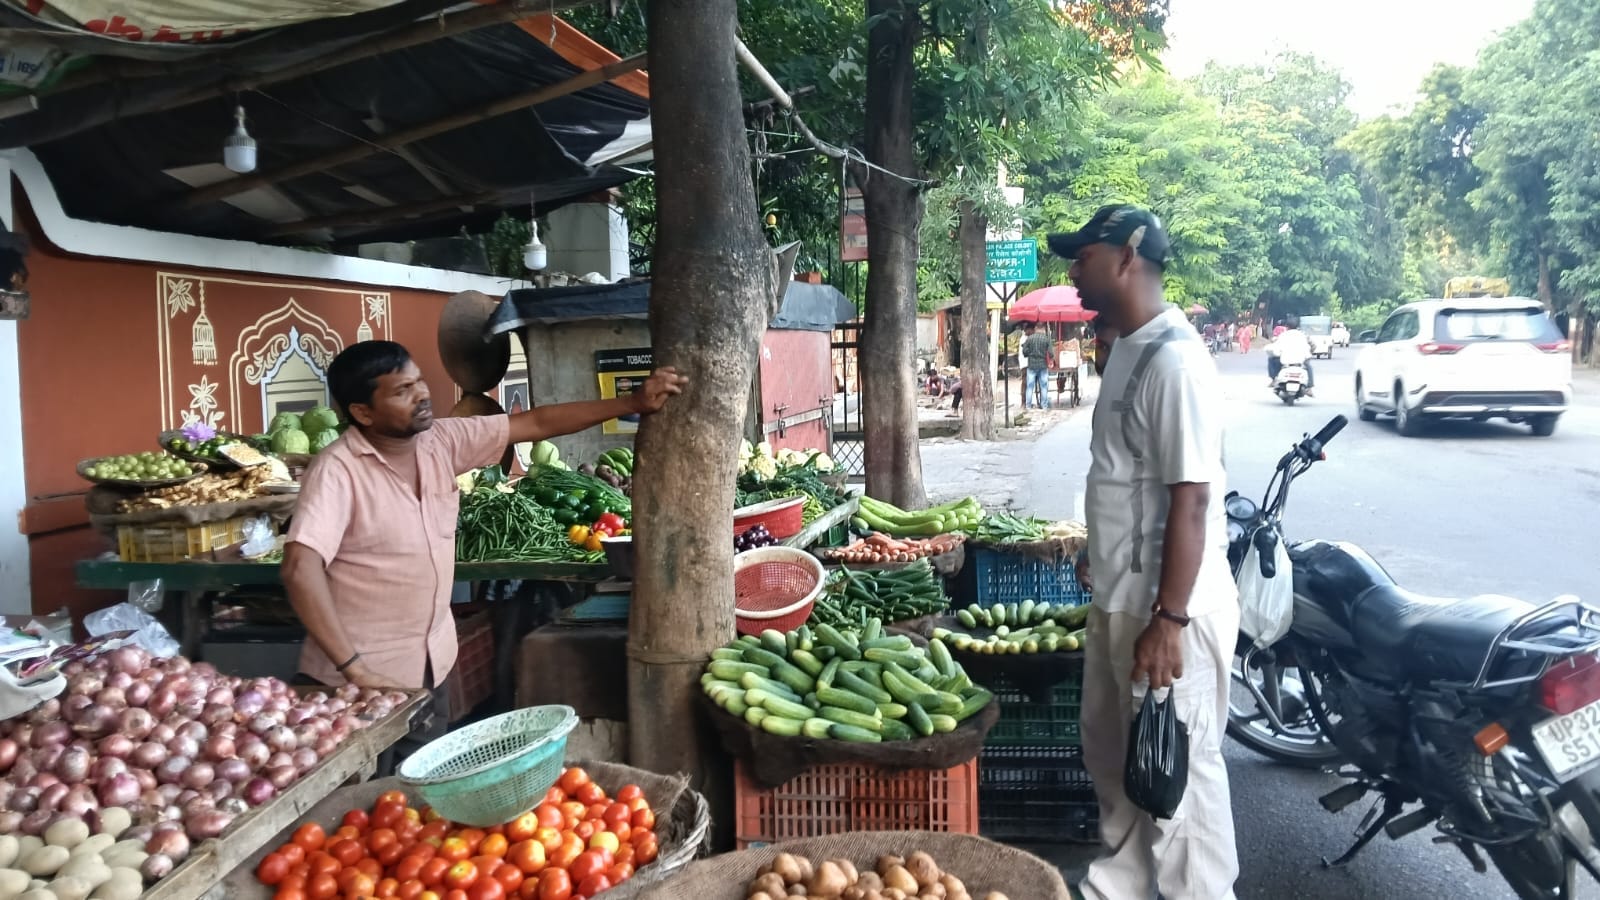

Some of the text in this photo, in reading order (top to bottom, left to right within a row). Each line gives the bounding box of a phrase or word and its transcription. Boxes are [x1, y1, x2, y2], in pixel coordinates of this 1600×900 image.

[986, 257, 1026, 267] OWER-1
[1548, 700, 1600, 742] UP32
[1562, 727, 1600, 763] S51
